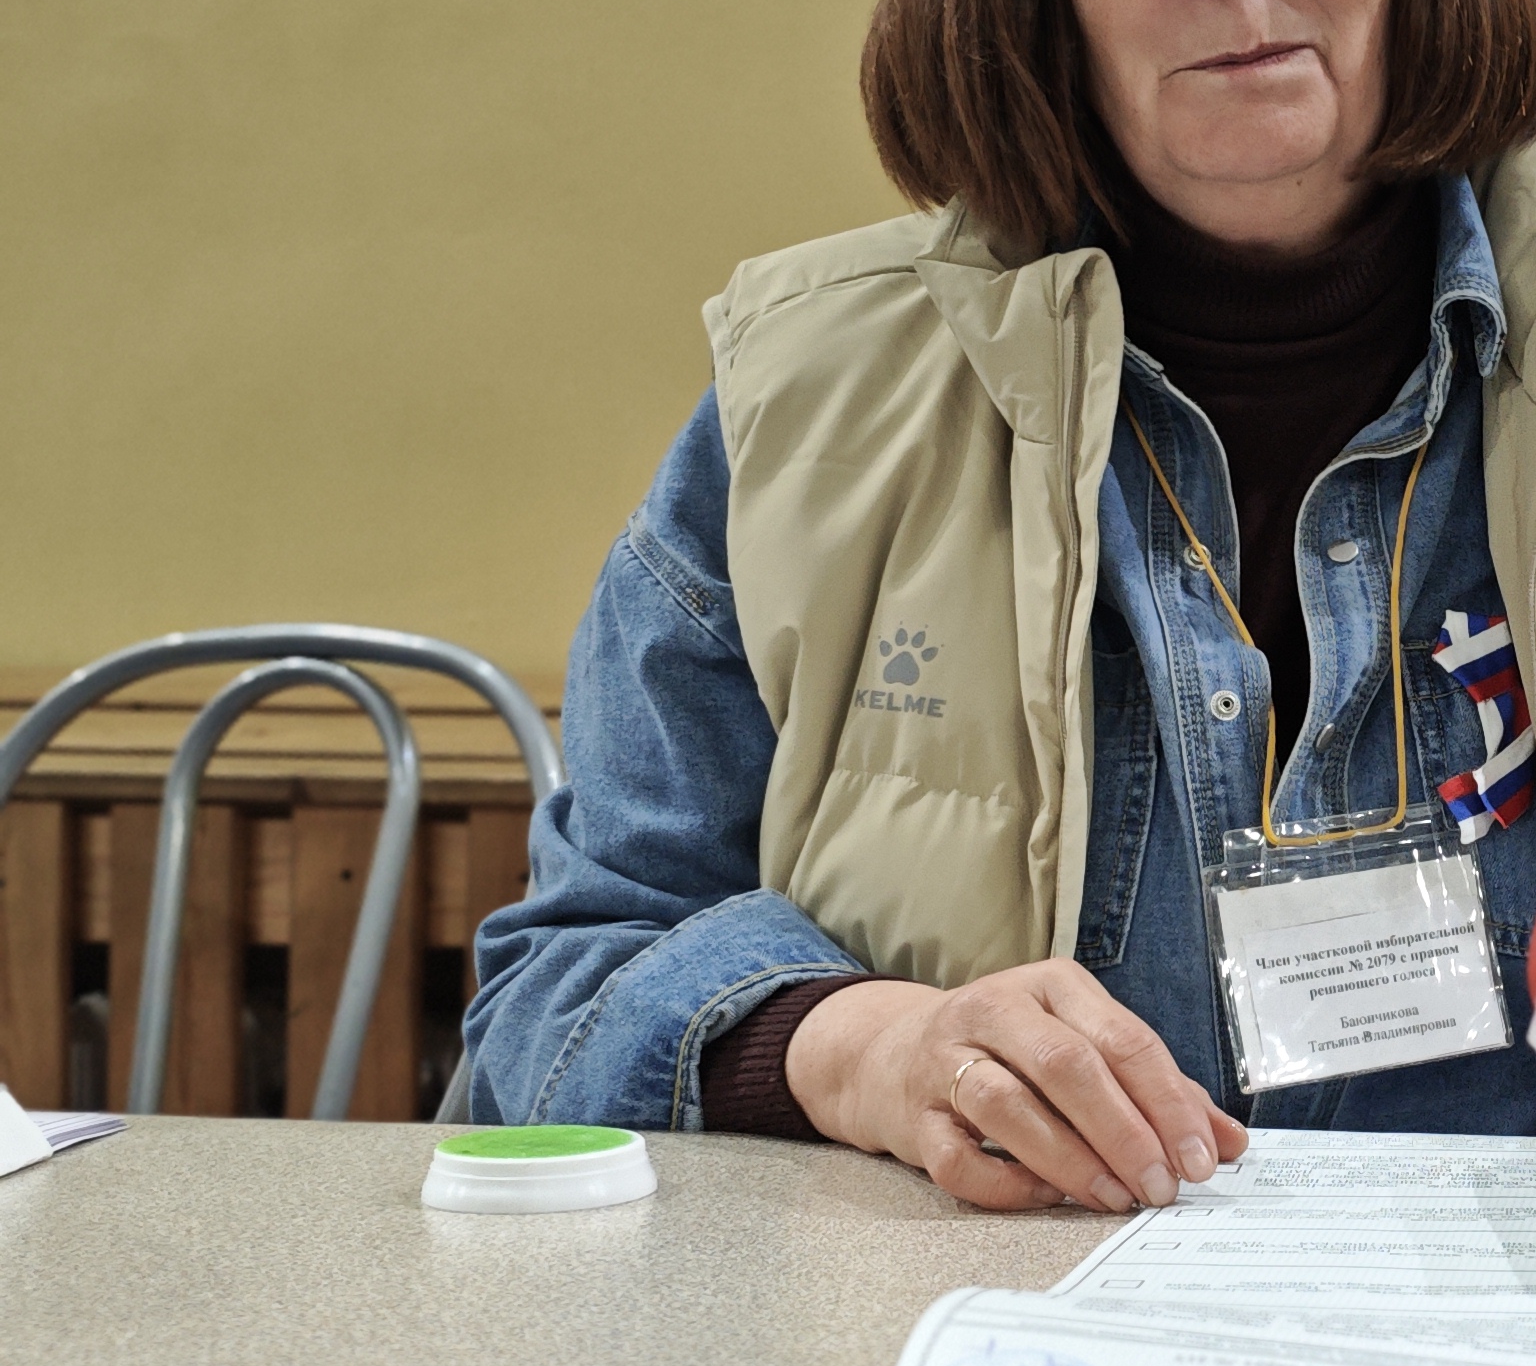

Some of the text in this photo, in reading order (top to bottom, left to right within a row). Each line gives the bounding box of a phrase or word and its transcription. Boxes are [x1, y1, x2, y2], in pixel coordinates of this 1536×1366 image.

[854, 689, 947, 718] KELME
[1256, 921, 1475, 970] Член участковой избирательной
[1279, 964, 1345, 985] комиссии
[1367, 952, 1396, 969] 2079
[1400, 954, 1407, 963] с
[1410, 944, 1459, 965] правом
[1309, 966, 1436, 1001] решающего голоса
[1308, 1017, 1457, 1053] Татьяна Владимировна
